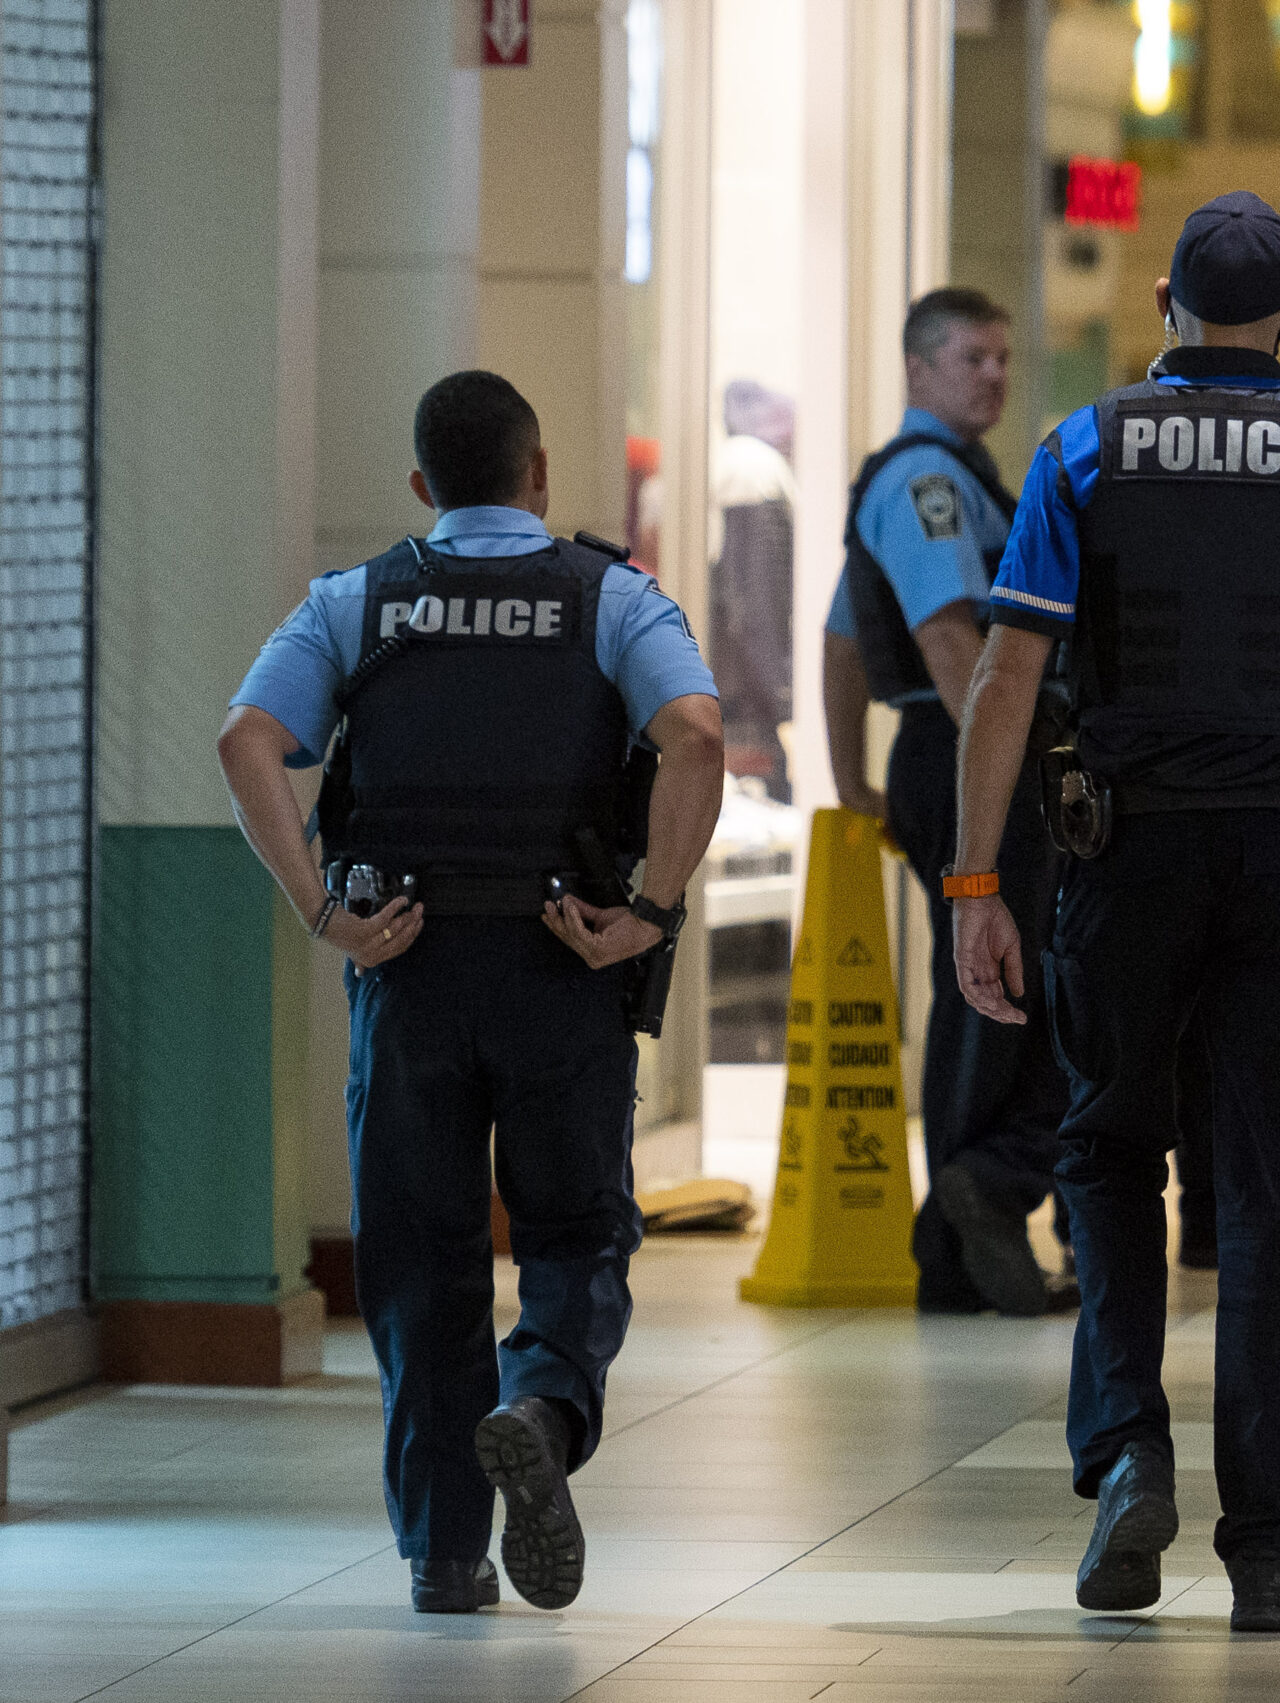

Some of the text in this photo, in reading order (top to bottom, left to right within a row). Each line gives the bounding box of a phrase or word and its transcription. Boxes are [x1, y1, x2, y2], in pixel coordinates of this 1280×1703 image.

[379, 595, 562, 638] POLICE
[828, 1001, 884, 1027] CAUTION
[828, 1042, 890, 1067] CUIDADO
[825, 1085, 896, 1109] ATTENTION
